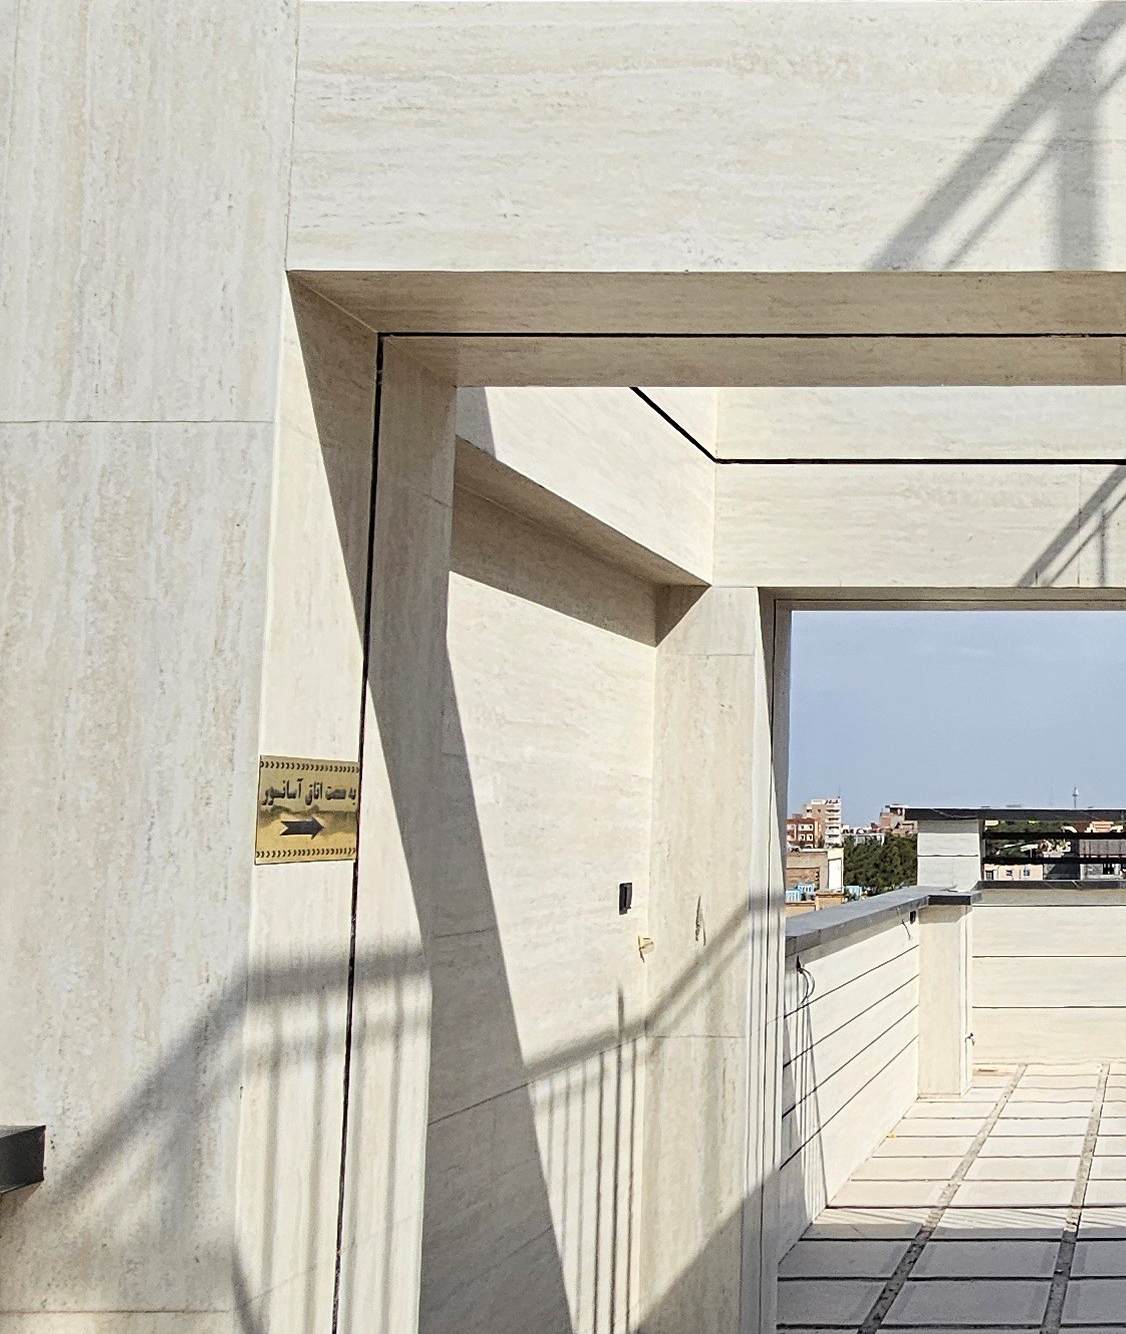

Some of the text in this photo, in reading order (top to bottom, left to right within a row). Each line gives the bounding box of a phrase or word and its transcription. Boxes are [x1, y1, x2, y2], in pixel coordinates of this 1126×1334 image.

[261, 778, 357, 806] به سمت اتاق آسانسور
